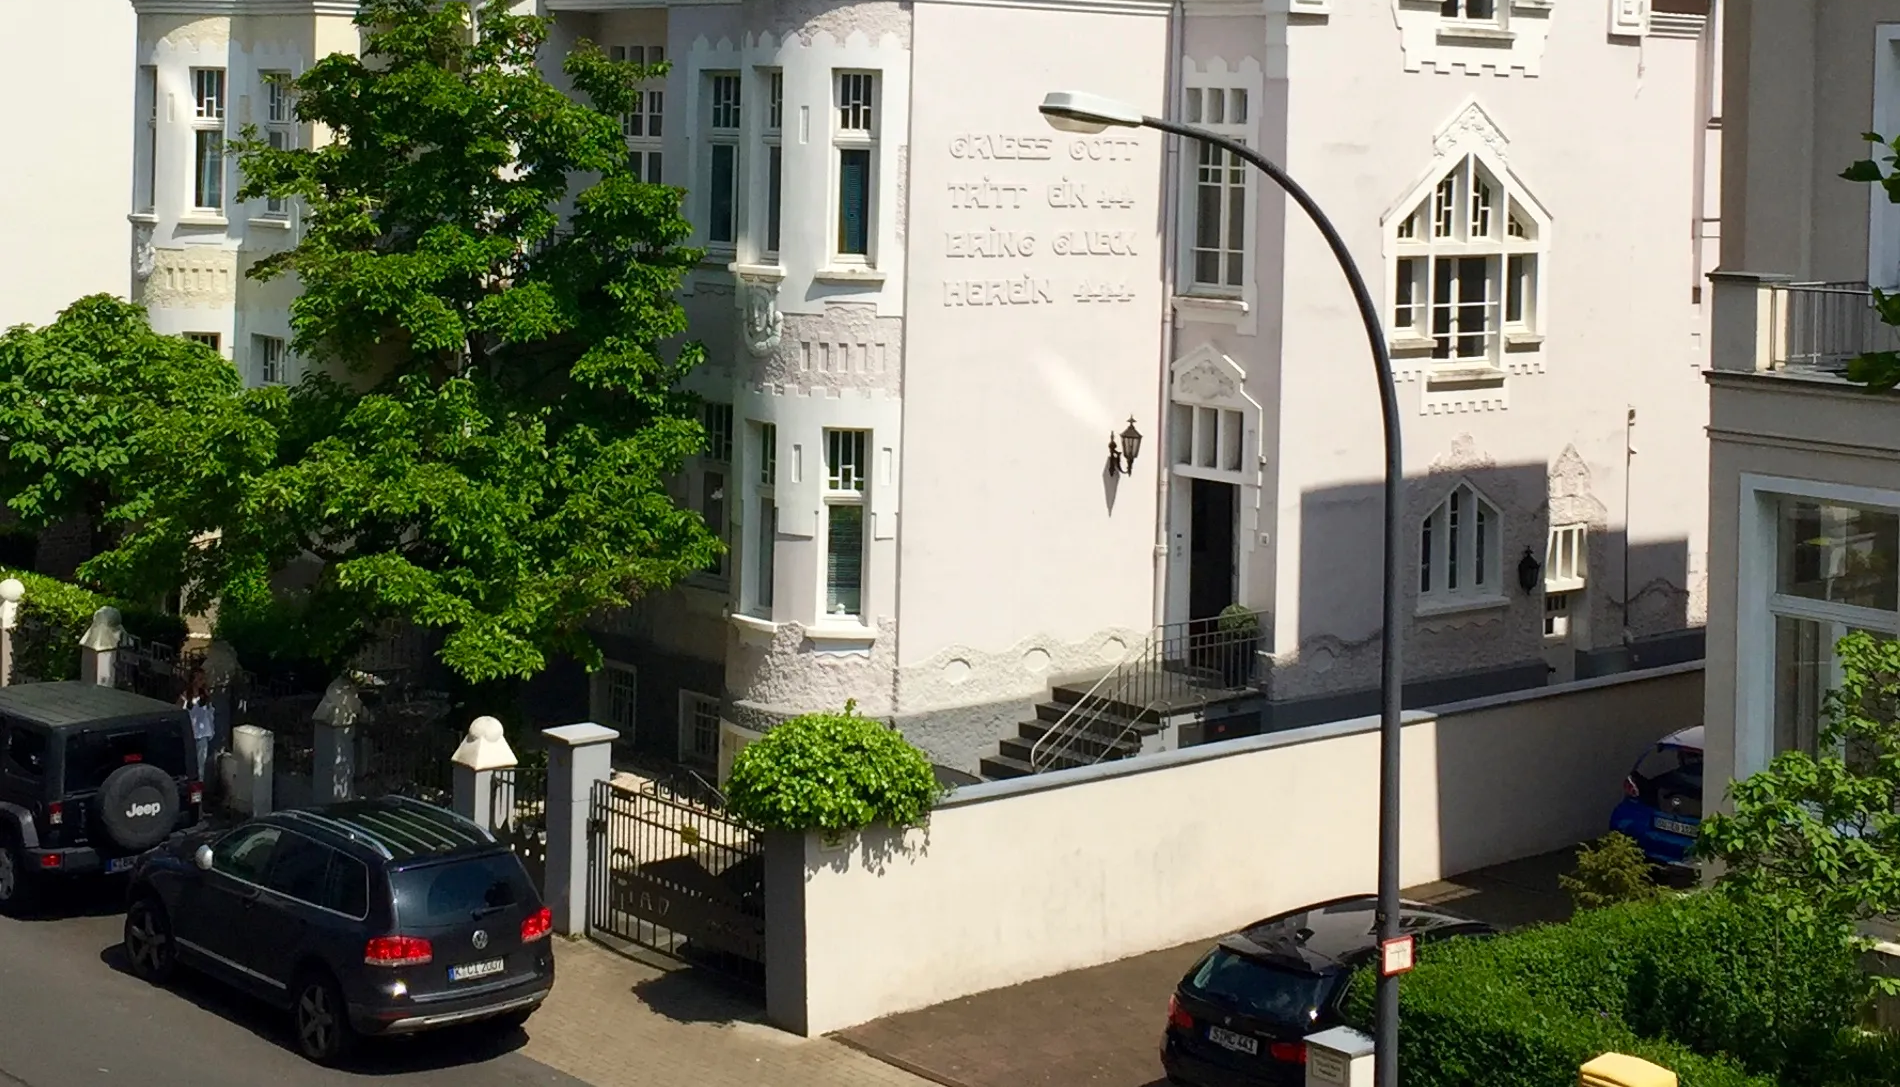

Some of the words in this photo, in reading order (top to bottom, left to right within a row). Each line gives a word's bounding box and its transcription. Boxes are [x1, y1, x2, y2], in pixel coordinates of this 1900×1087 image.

[1069, 137, 1139, 161] GOTT
[947, 176, 1028, 209] TRITT
[1047, 176, 1088, 209] EIN
[945, 227, 1036, 258] BRING
[943, 274, 1054, 307] HEREIN
[126, 802, 160, 818] Jeep
